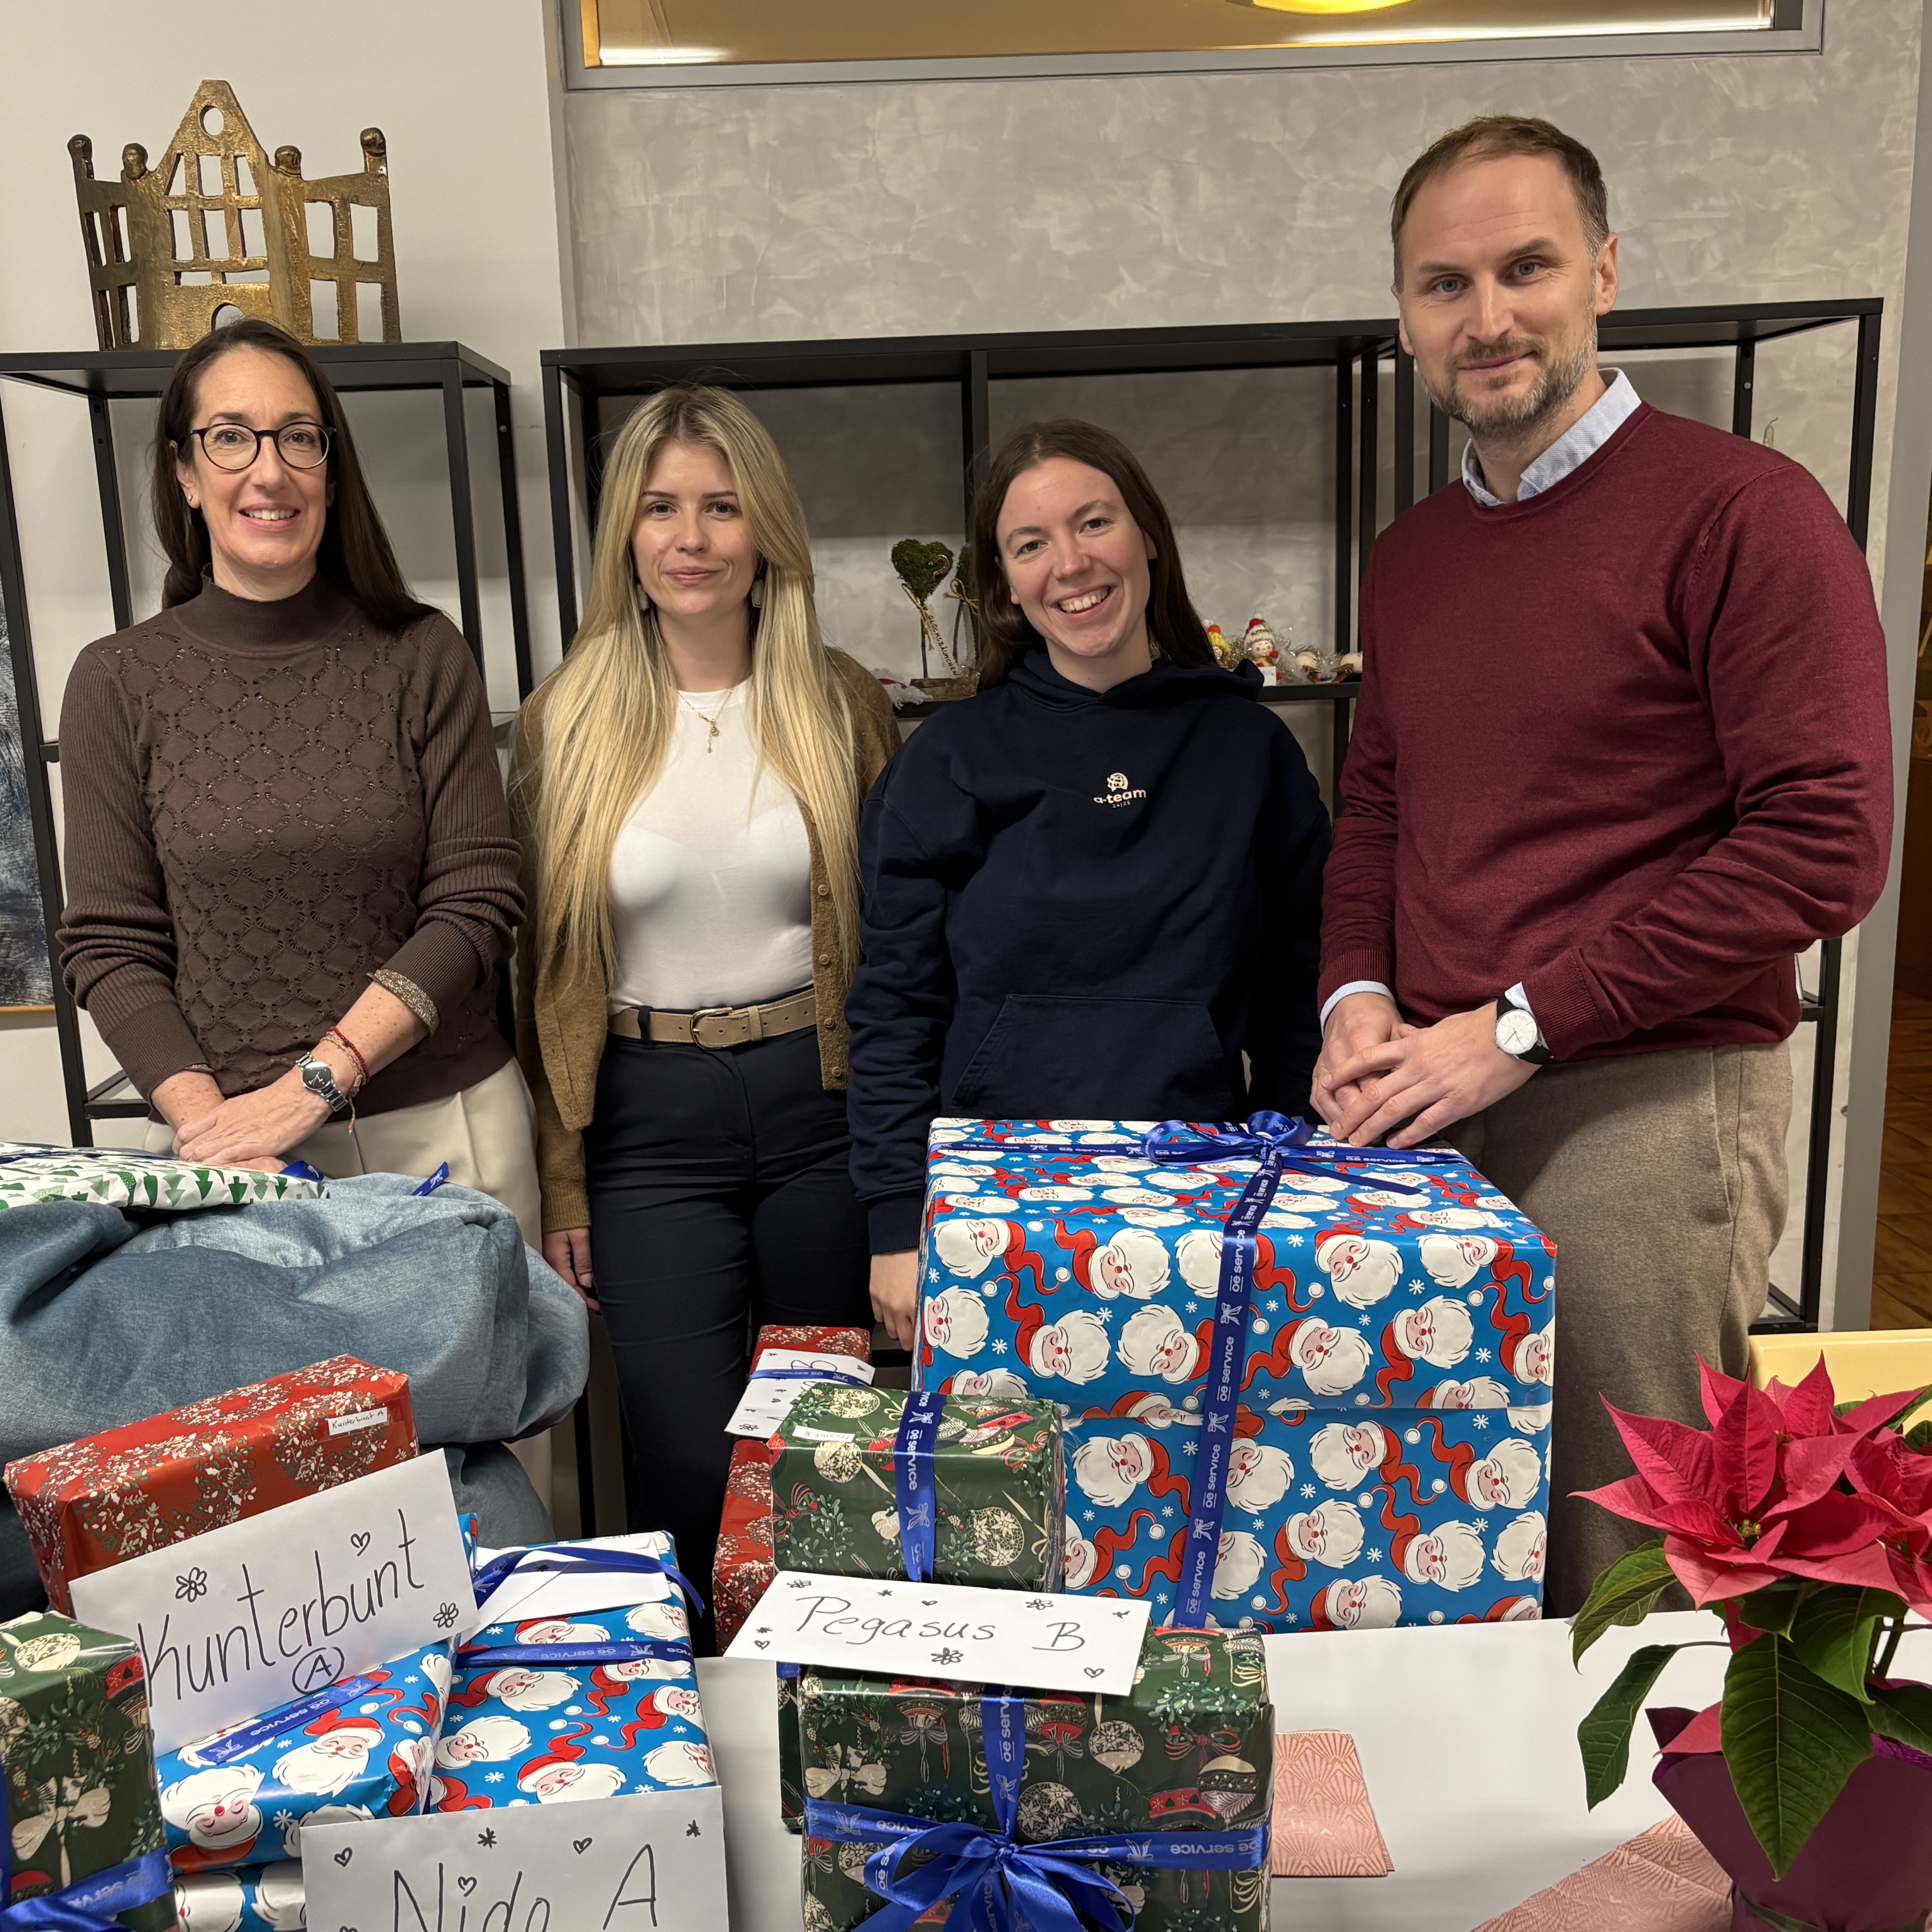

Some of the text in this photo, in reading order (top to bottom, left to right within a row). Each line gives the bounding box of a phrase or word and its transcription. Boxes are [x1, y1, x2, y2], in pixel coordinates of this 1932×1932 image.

[1093, 789, 1146, 803] a-team
[1231, 1229, 1246, 1292] oe service
[1218, 1336, 1235, 1401] oe service
[332, 1412, 374, 1429] Kunterbunt
[907, 1429, 921, 1491] oe service
[1204, 1443, 1221, 1508] oe service
[1187, 1551, 1206, 1614] oe service
[138, 1508, 425, 1708] Kunterbunt
[795, 1595, 1086, 1651] Pegasus B
[301, 1652, 335, 1692] A
[540, 1650, 595, 1659] service
[250, 1699, 332, 1736] oe service
[1001, 1741, 1013, 1762] oe
[1170, 1840, 1259, 1855] oe service
[394, 1843, 658, 1932] Nido A
[877, 1869, 887, 1890] oe
